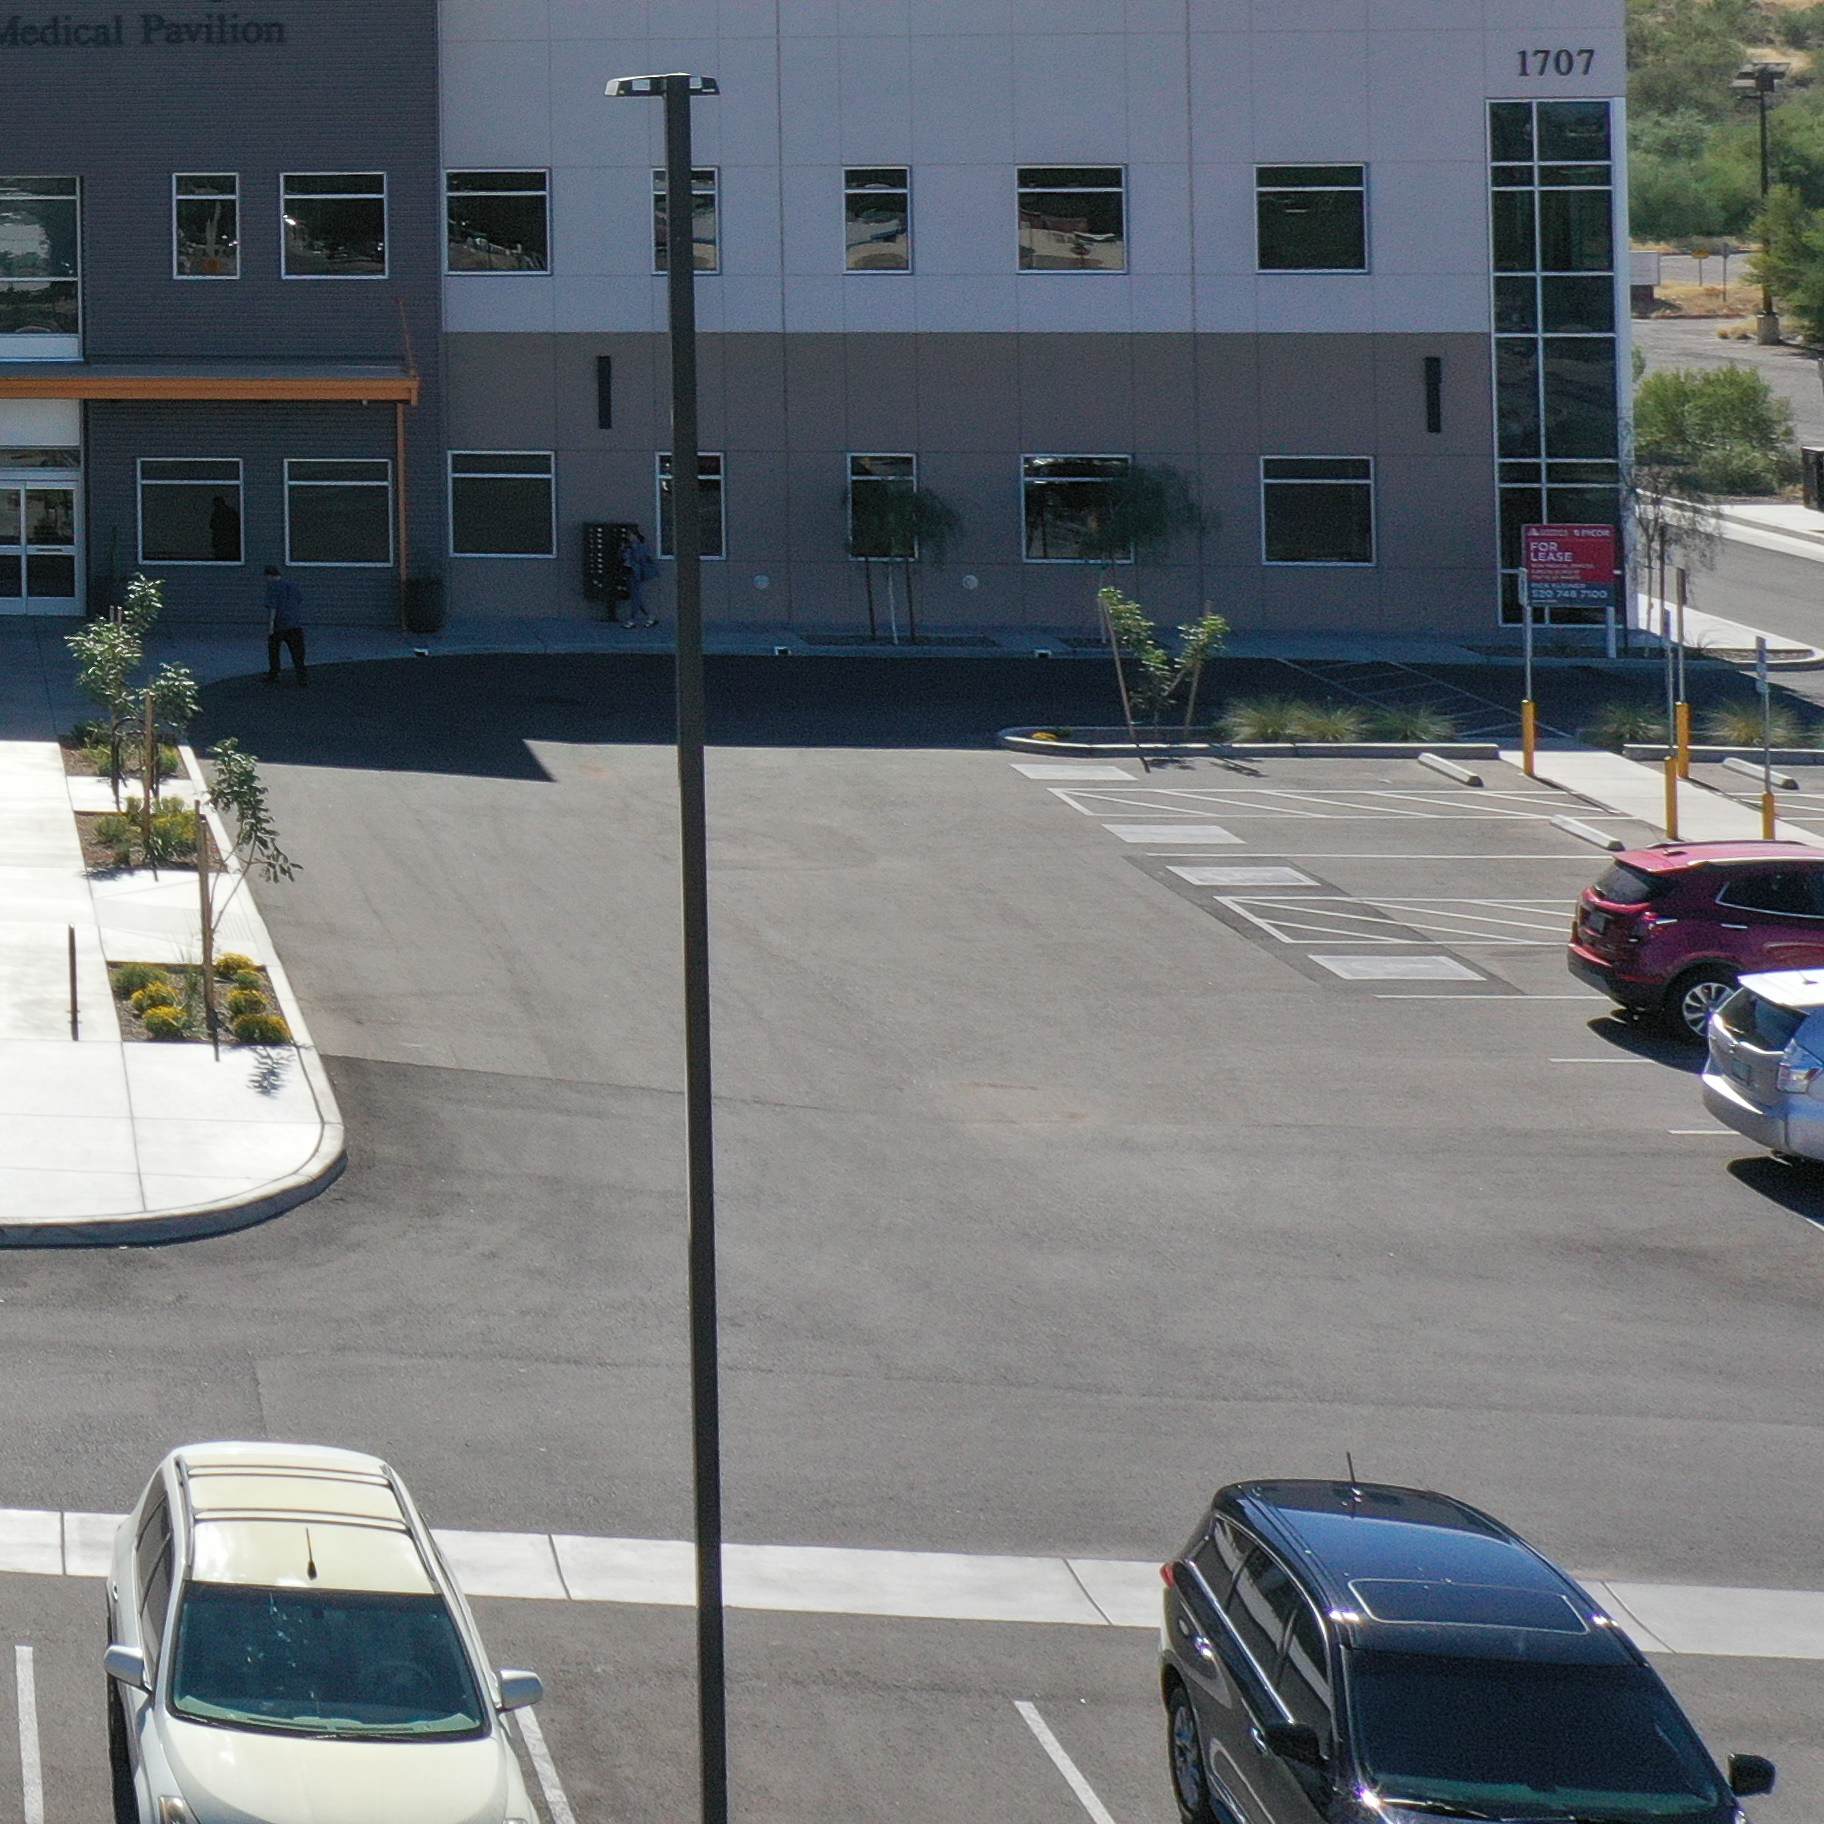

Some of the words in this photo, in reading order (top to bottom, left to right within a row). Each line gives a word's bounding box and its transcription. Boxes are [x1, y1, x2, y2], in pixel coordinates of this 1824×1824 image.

[140, 12, 287, 45] Pavilion
[1518, 48, 1595, 77] 1707
[1530, 541, 1558, 552] FOR
[1530, 551, 1574, 562] LEASE
